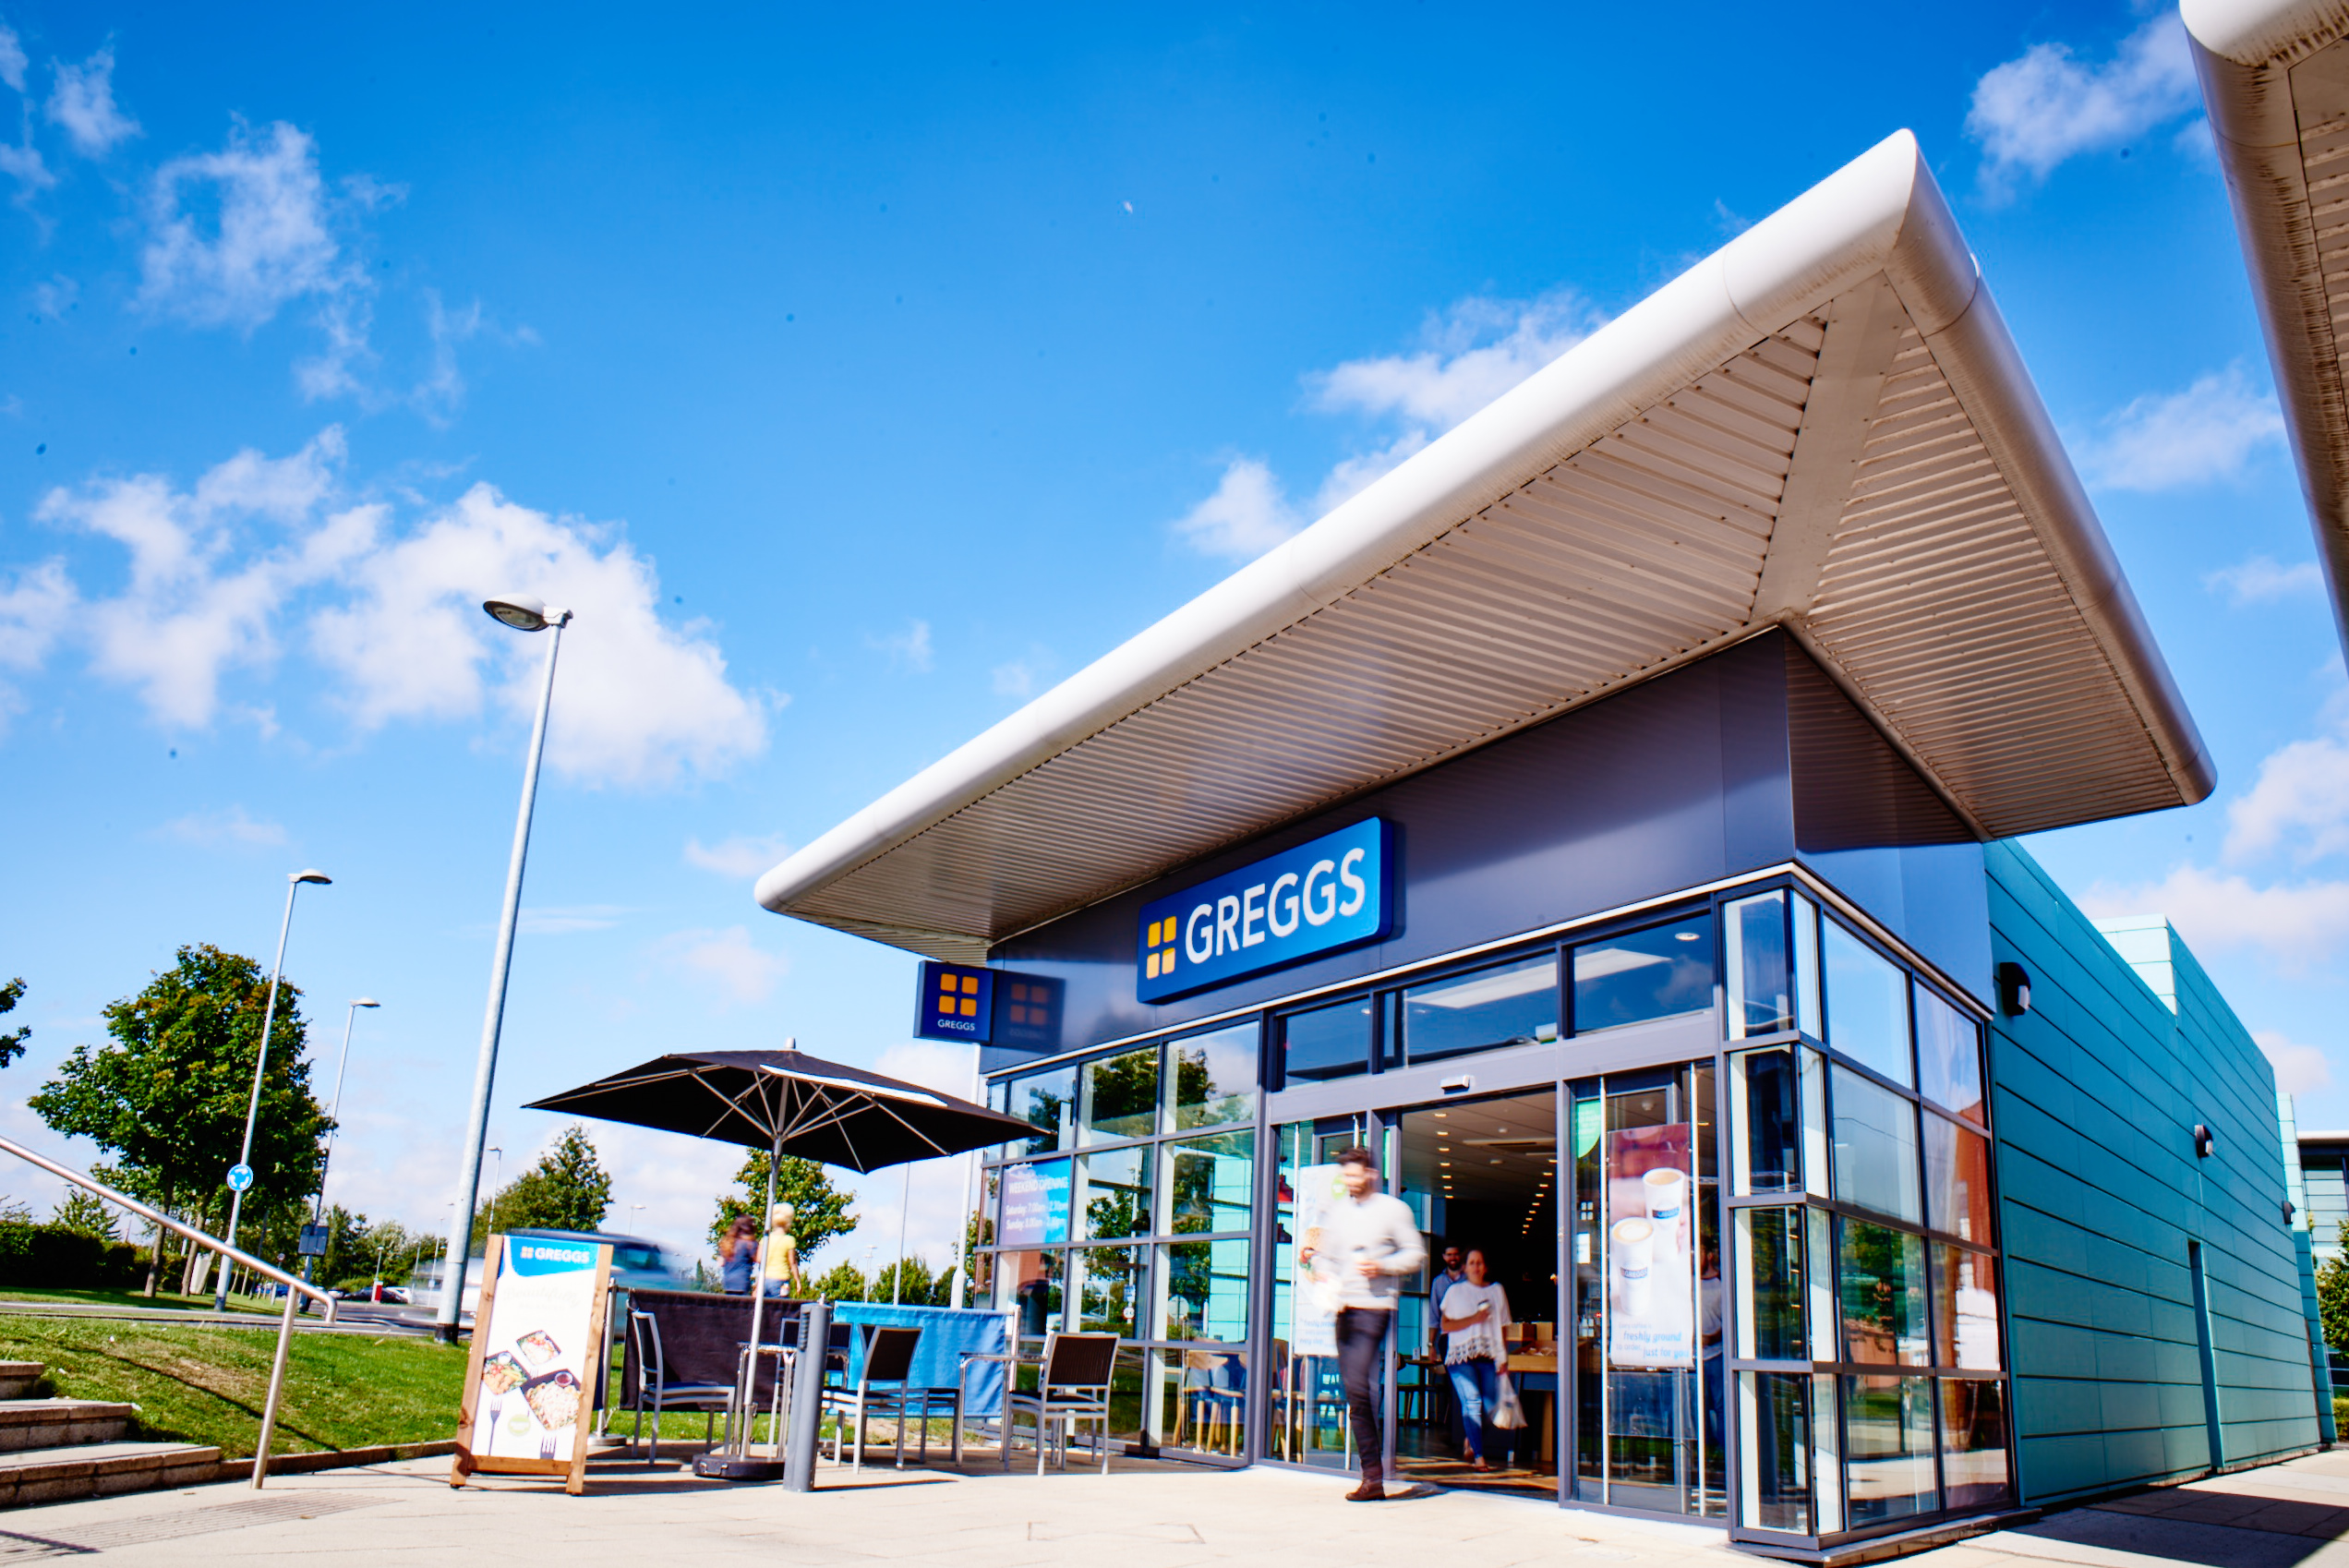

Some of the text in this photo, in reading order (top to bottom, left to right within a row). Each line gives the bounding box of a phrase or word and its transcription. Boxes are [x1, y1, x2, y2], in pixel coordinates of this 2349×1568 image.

[1185, 848, 1366, 964] GREGGS
[937, 1019, 976, 1031] GREGGS
[1008, 1179, 1039, 1195] WEEKEND
[535, 1247, 590, 1264] GREGGS
[503, 1286, 581, 1308] Beautifully
[1623, 1331, 1682, 1344] freshly ground
[1643, 1346, 1658, 1358] just
[1660, 1346, 1671, 1357] for
